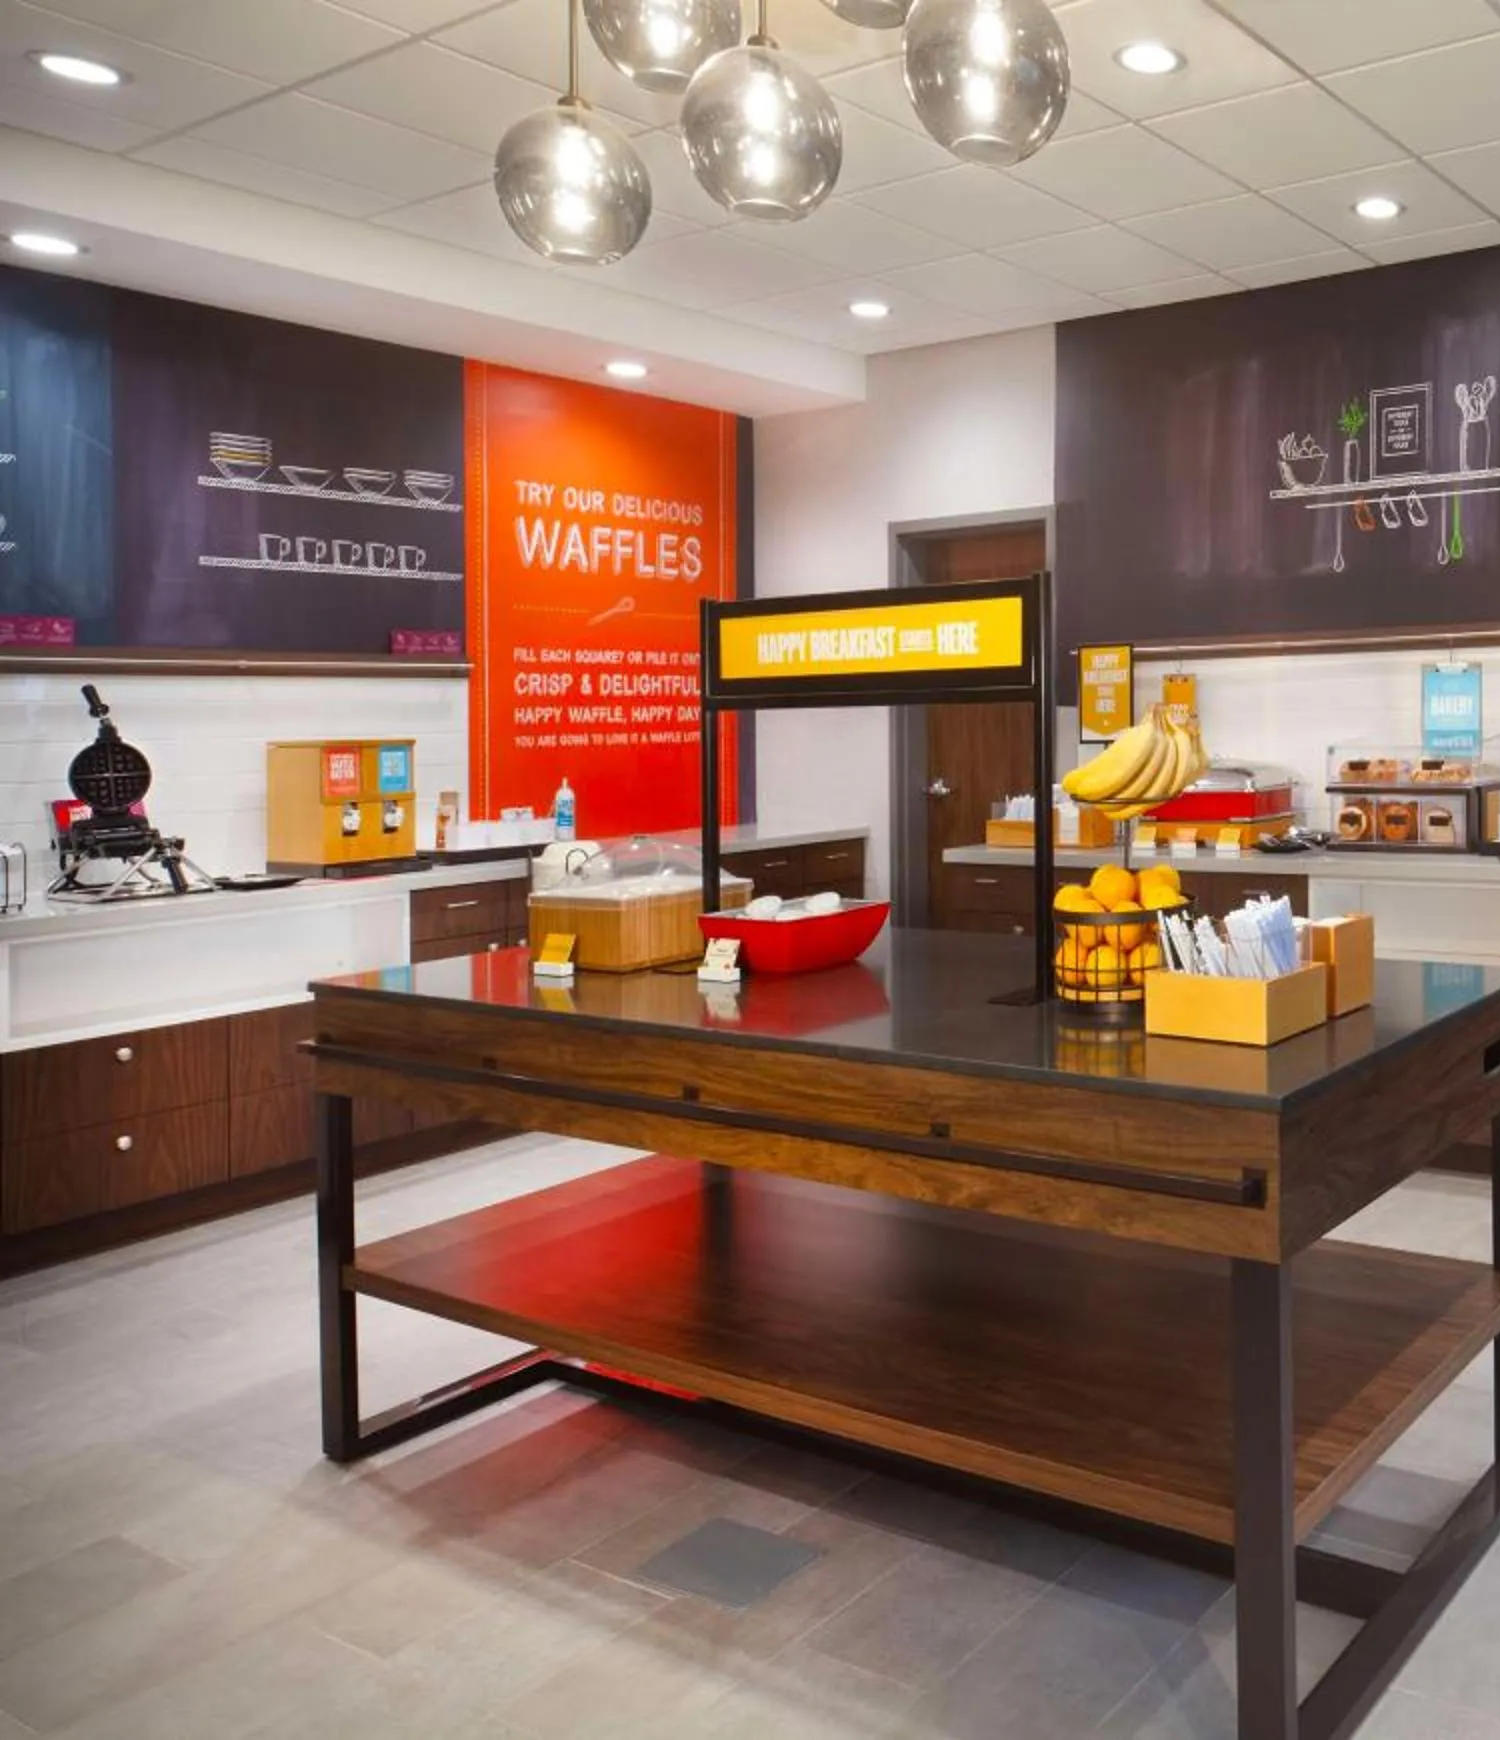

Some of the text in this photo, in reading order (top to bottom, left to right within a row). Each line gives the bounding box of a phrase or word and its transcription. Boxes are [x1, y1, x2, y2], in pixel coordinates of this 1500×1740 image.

[514, 479, 704, 527] TRY OUR DELICIOUS
[514, 514, 704, 584] WAFFLES
[757, 631, 807, 665] HAPPY
[810, 625, 896, 662] BREAKFAST
[937, 620, 979, 656] HERE
[513, 647, 537, 664] FILL
[540, 648, 572, 665] EACH
[627, 651, 643, 666] OR
[514, 671, 701, 698] CRISP & DELIGHTFUL
[514, 706, 701, 726] HAPPY WAFFLE, HAPPY DAY
[1430, 695, 1473, 716] BAKERY
